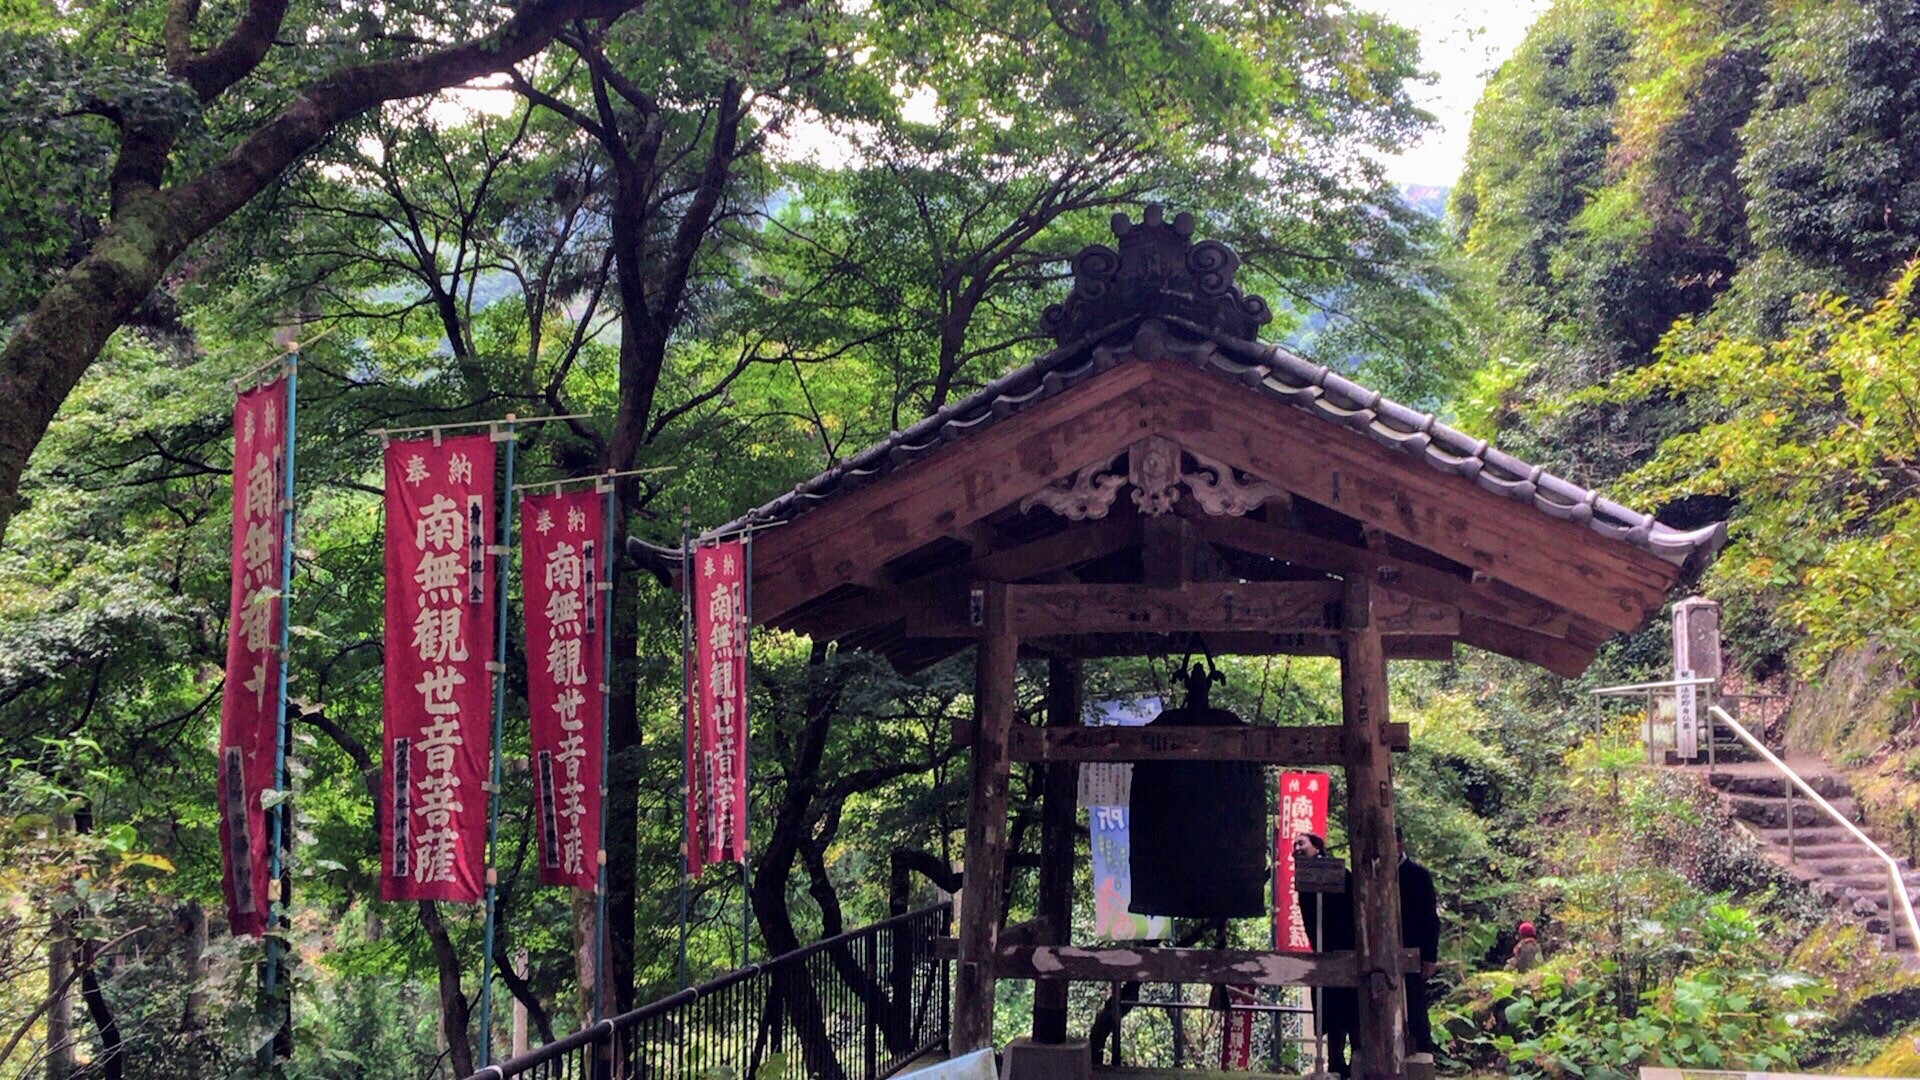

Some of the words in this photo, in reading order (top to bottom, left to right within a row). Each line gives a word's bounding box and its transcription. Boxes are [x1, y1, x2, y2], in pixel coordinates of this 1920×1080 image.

[405, 453, 472, 487] 奉納
[536, 505, 586, 536] 奉納
[704, 554, 735, 579] 奉納
[411, 494, 469, 883] 南無観世音菩薩
[544, 541, 587, 875] 南無観世音菩薩
[709, 583, 737, 850] 南無観世音菩薩
